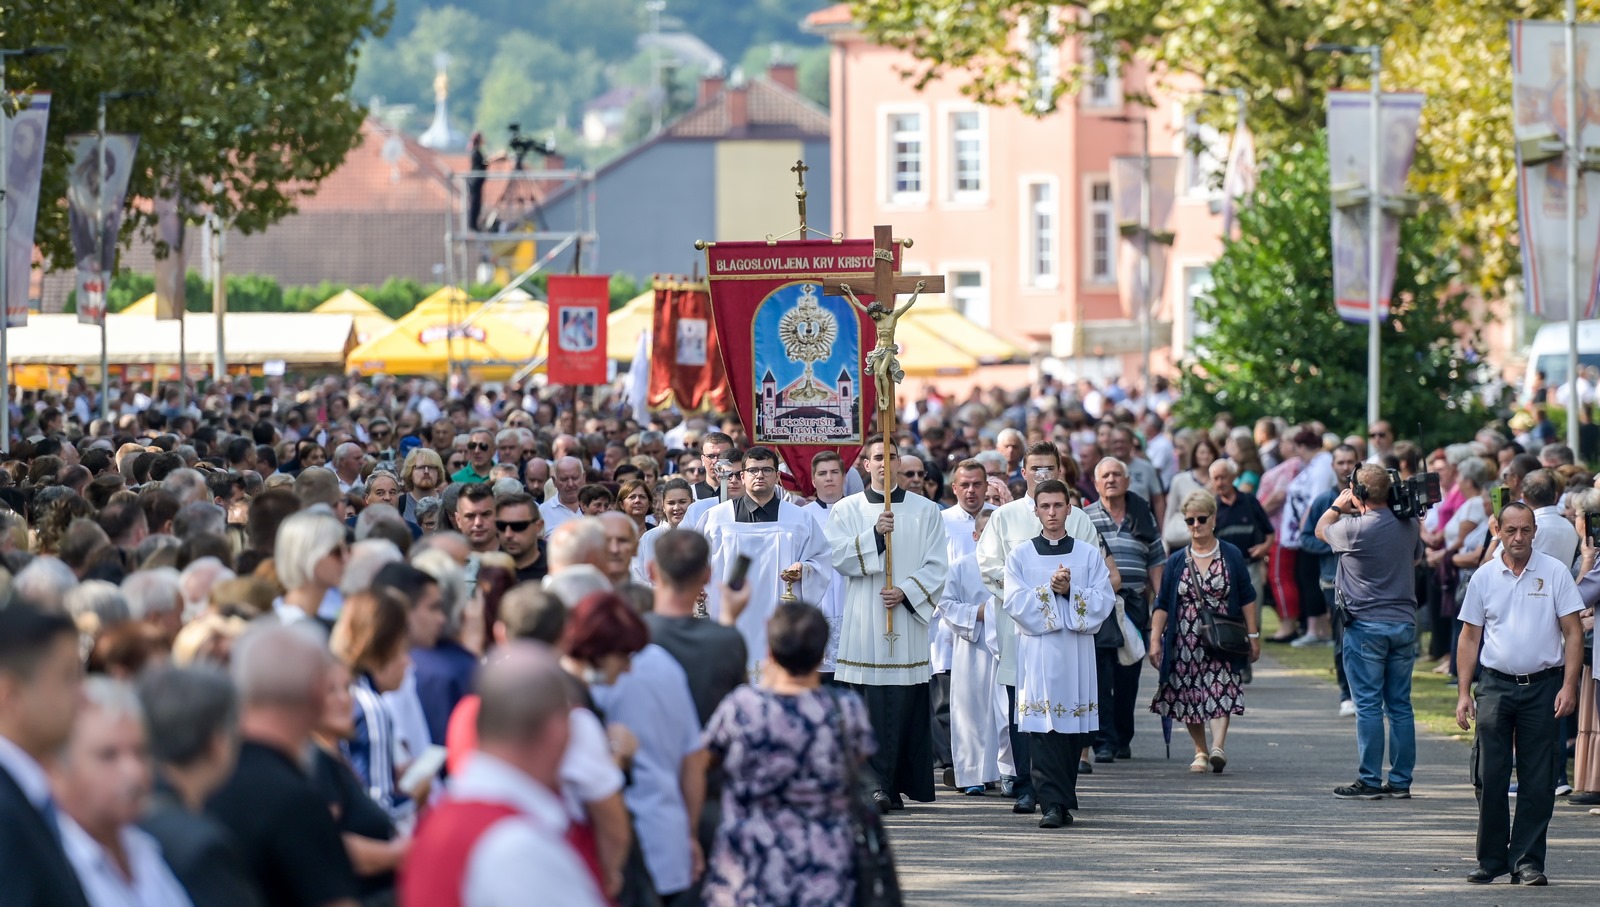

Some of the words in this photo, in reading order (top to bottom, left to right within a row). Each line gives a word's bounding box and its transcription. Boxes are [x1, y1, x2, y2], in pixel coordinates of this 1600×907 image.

[716, 257, 810, 271] BLAGOSLOVLJENA
[813, 257, 834, 269] KRV
[838, 256, 875, 268] KRISTO
[781, 417, 835, 426] PROŠTENIŠTE
[815, 427, 850, 435] ISUSOVE
